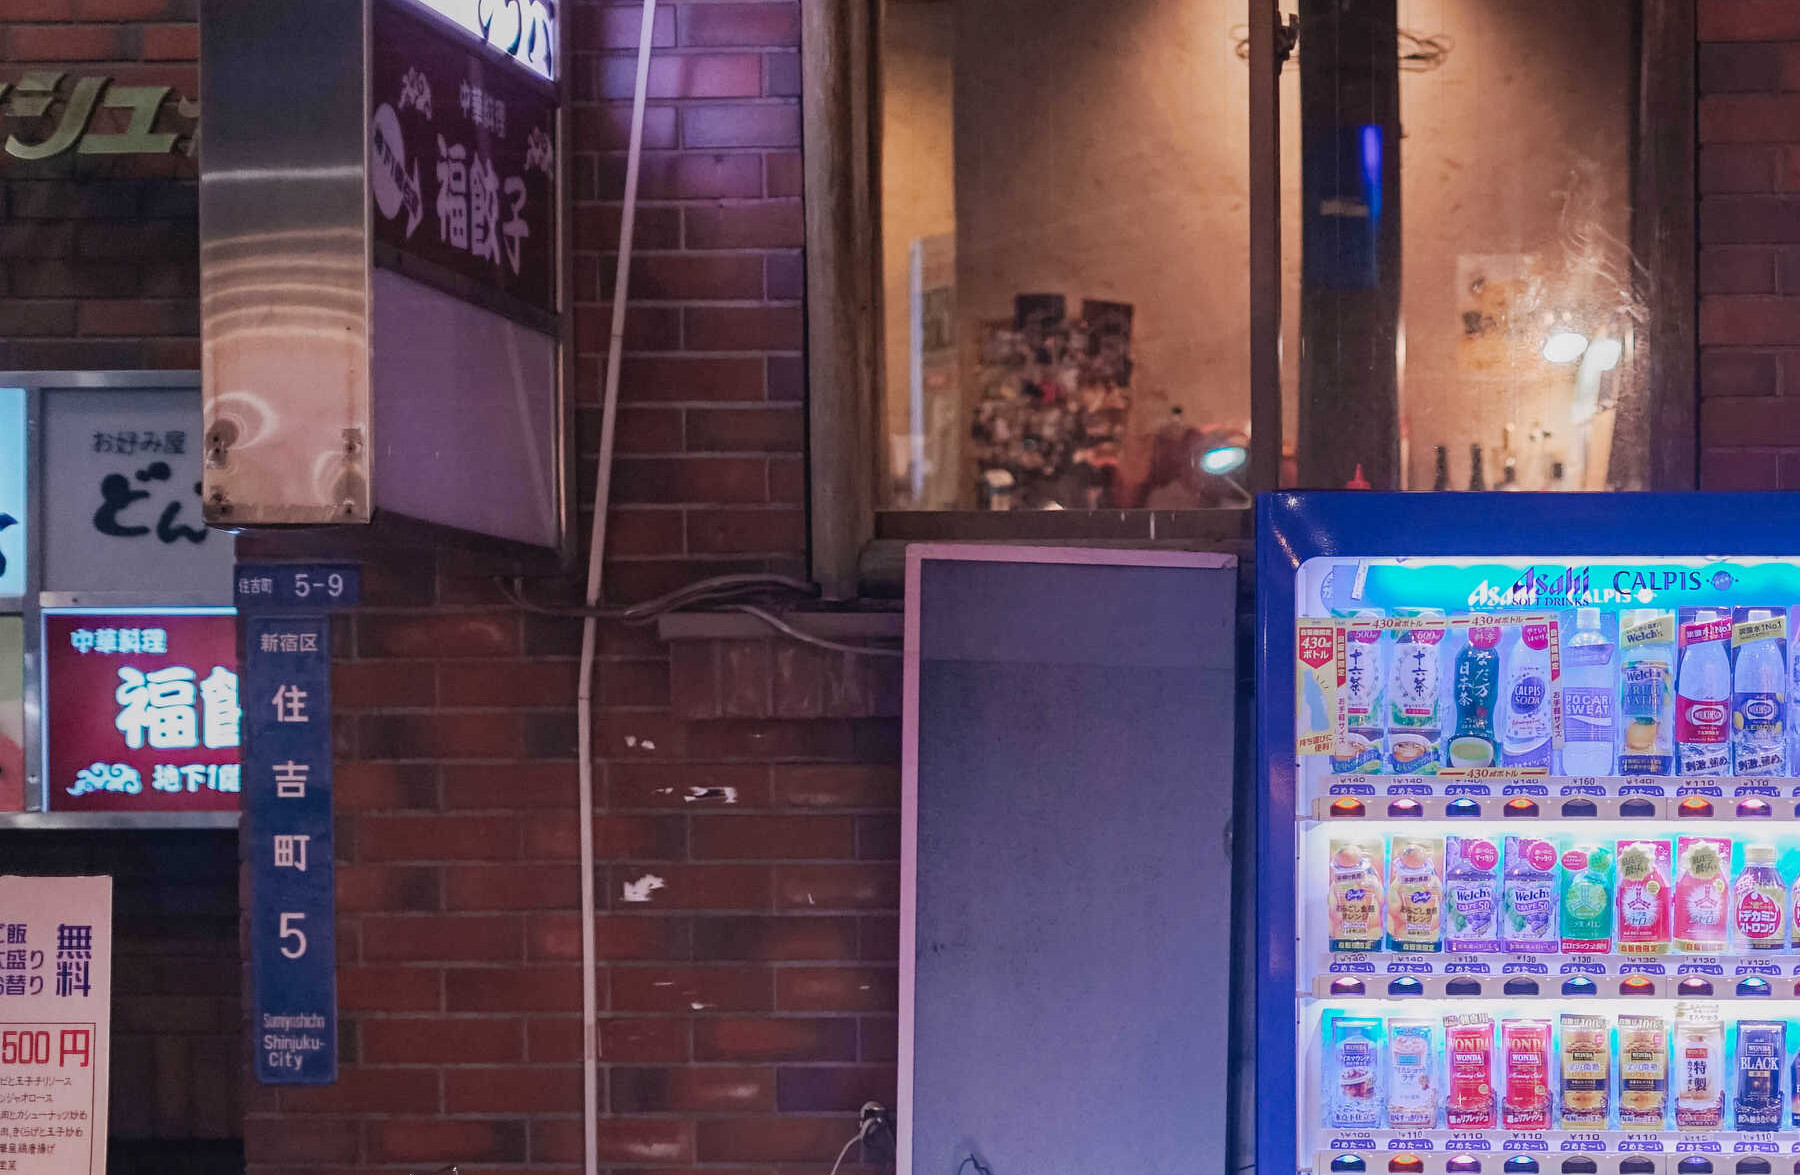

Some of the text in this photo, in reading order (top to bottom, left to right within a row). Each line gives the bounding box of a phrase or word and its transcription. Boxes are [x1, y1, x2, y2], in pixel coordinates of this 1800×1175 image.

[0, 70, 198, 158] シュ
[93, 461, 208, 543] どん
[238, 574, 344, 597] 住吉町 5-9
[1513, 566, 1589, 595] Asahi
[1613, 571, 1701, 594] CALPIS
[70, 628, 167, 655] 中華料理
[260, 633, 318, 653] 新宿区
[1457, 661, 1474, 707] 日本茶
[1514, 685, 1543, 698] CALPIS
[1514, 696, 1542, 706] SODA
[1565, 704, 1610, 715] SWEAT
[1457, 889, 1492, 901] Welch's
[56, 923, 92, 997] 無料
[264, 1034, 326, 1052] Shinjuku-
[268, 1052, 303, 1070] City
[1456, 1054, 1483, 1063] WONDA
[1741, 1057, 1779, 1071] BLACK
